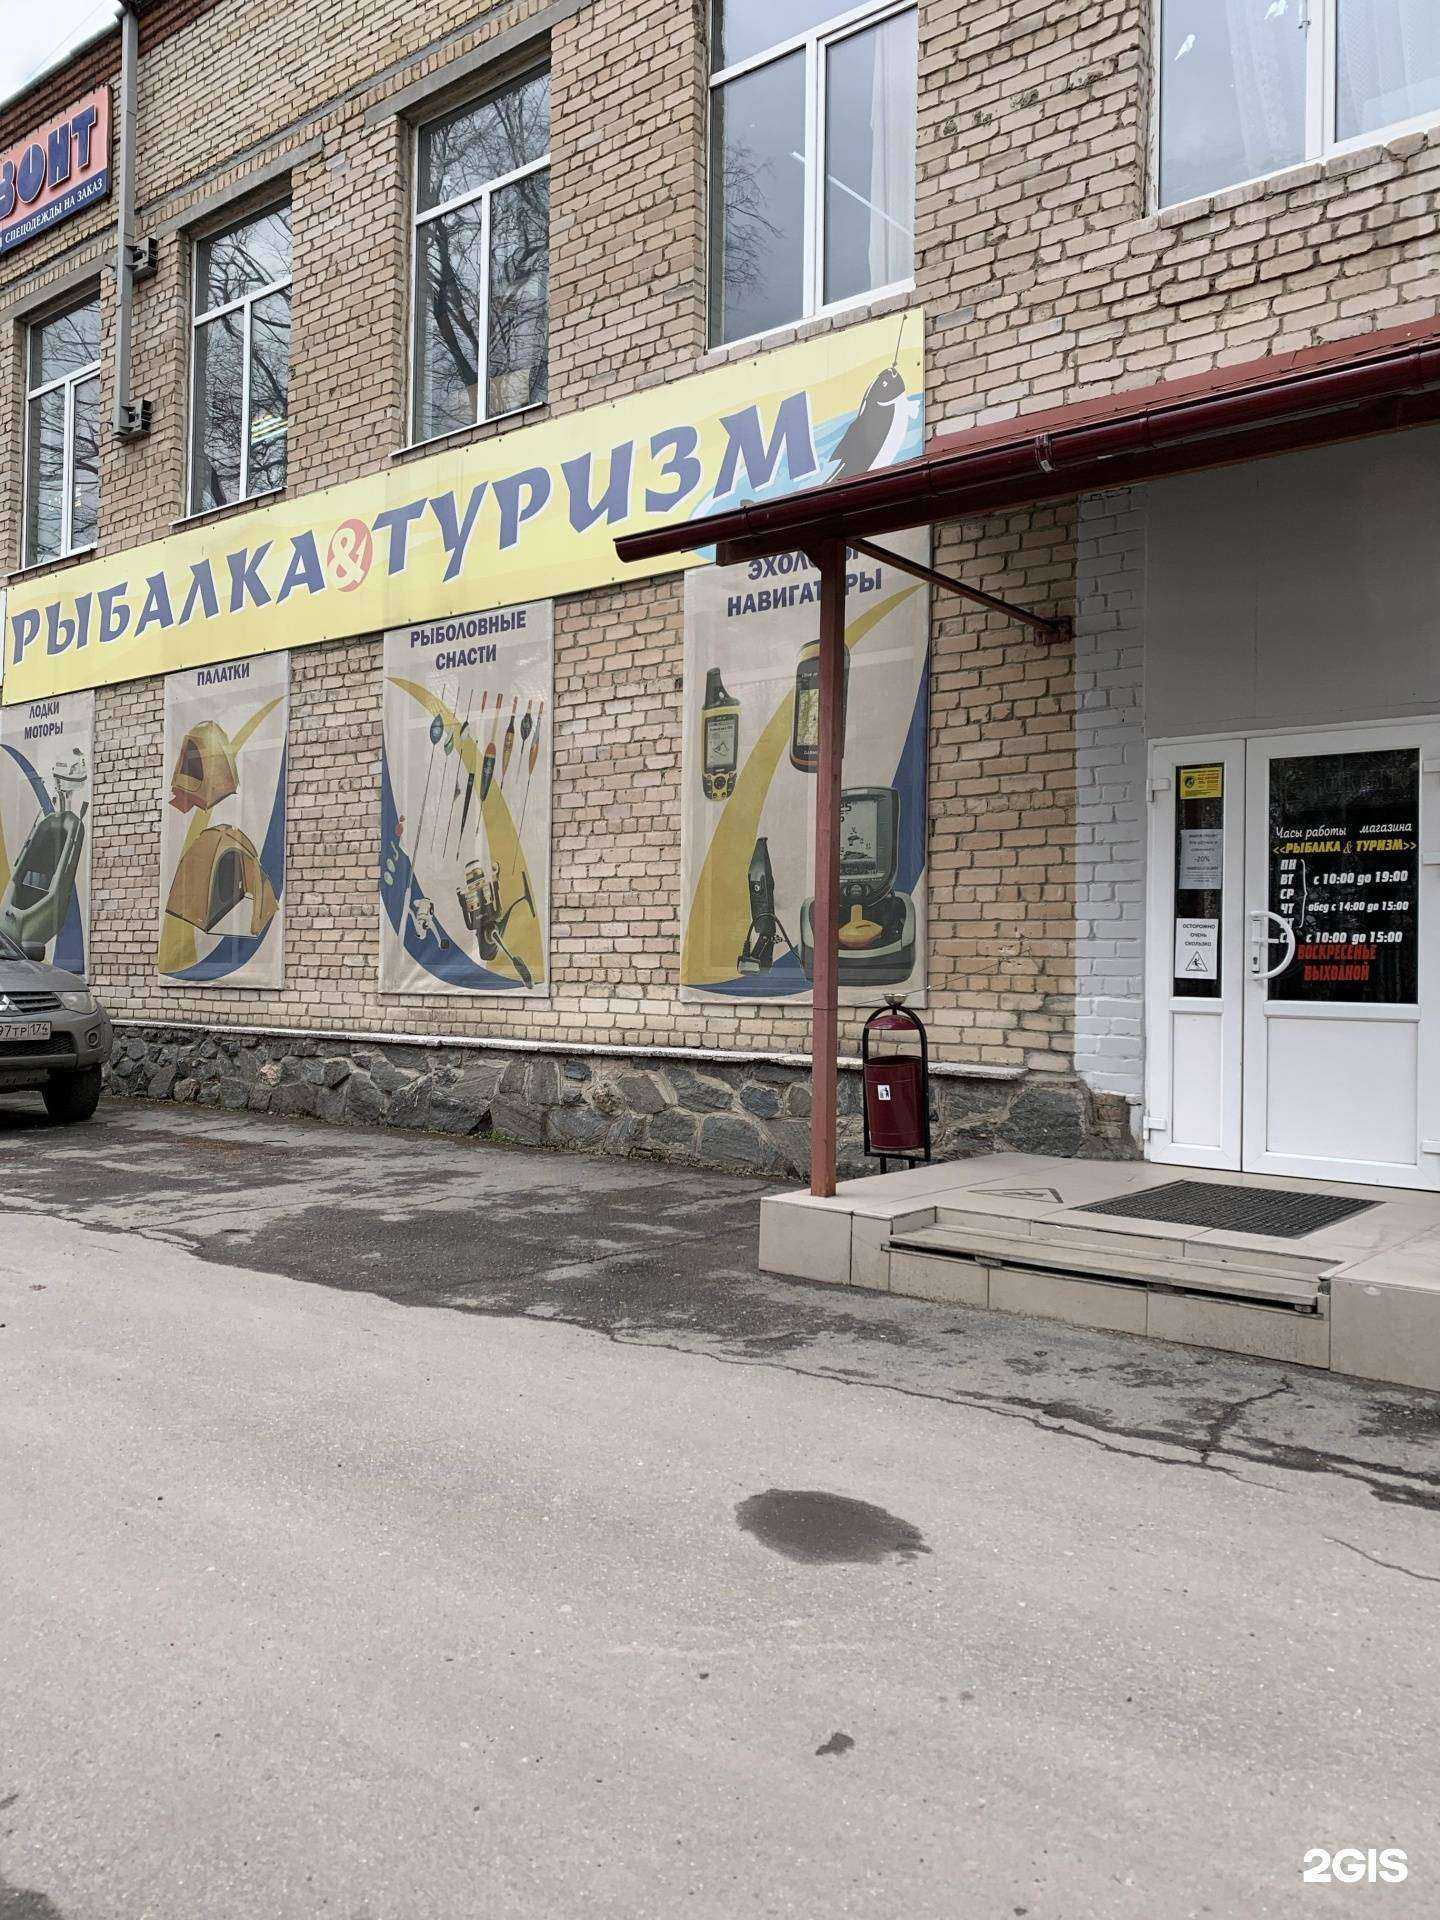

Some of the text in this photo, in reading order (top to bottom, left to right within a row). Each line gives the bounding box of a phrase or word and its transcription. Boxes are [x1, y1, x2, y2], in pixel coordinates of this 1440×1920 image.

[5, 201, 62, 244] СПЕЦОДЕЖДЫ
[64, 196, 76, 211] НА
[77, 178, 103, 202] ЗАКАЗ
[11, 529, 327, 666] РЫБАЛКА
[371, 391, 817, 583] ТУРИЗМ
[727, 568, 882, 617] НАВИГАТРЫ
[410, 610, 527, 648] РЫБОЛОВНЫЕ
[435, 644, 497, 670] СНАСТИ
[197, 662, 250, 687] ПАЛАТКИ
[29, 700, 60, 720] ЛОДКИ
[24, 721, 64, 740] МОТОРЫ
[1276, 823, 1412, 840] Часы работы магазина
[1280, 859, 1297, 870] ПН
[1280, 874, 1295, 885] ВТ
[1322, 872, 1355, 885] 10:00
[1357, 874, 1372, 886] до
[1375, 870, 1409, 883] 19:00
[1280, 889, 1295, 900] СР
[1280, 903, 1295, 914] ЧТ
[1308, 902, 1329, 913] обед
[1339, 901, 1365, 912] 14:00
[1367, 903, 1380, 913] до
[1382, 901, 1409, 911] 15:00
[1315, 931, 1348, 944] 10:00
[1351, 933, 1366, 945] до
[1369, 931, 1403, 943] 15:00
[1297, 943, 1377, 960] ВОСКРЕСЕНЬЕ
[1304, 961, 1370, 980] ВЫХОДНОЙ
